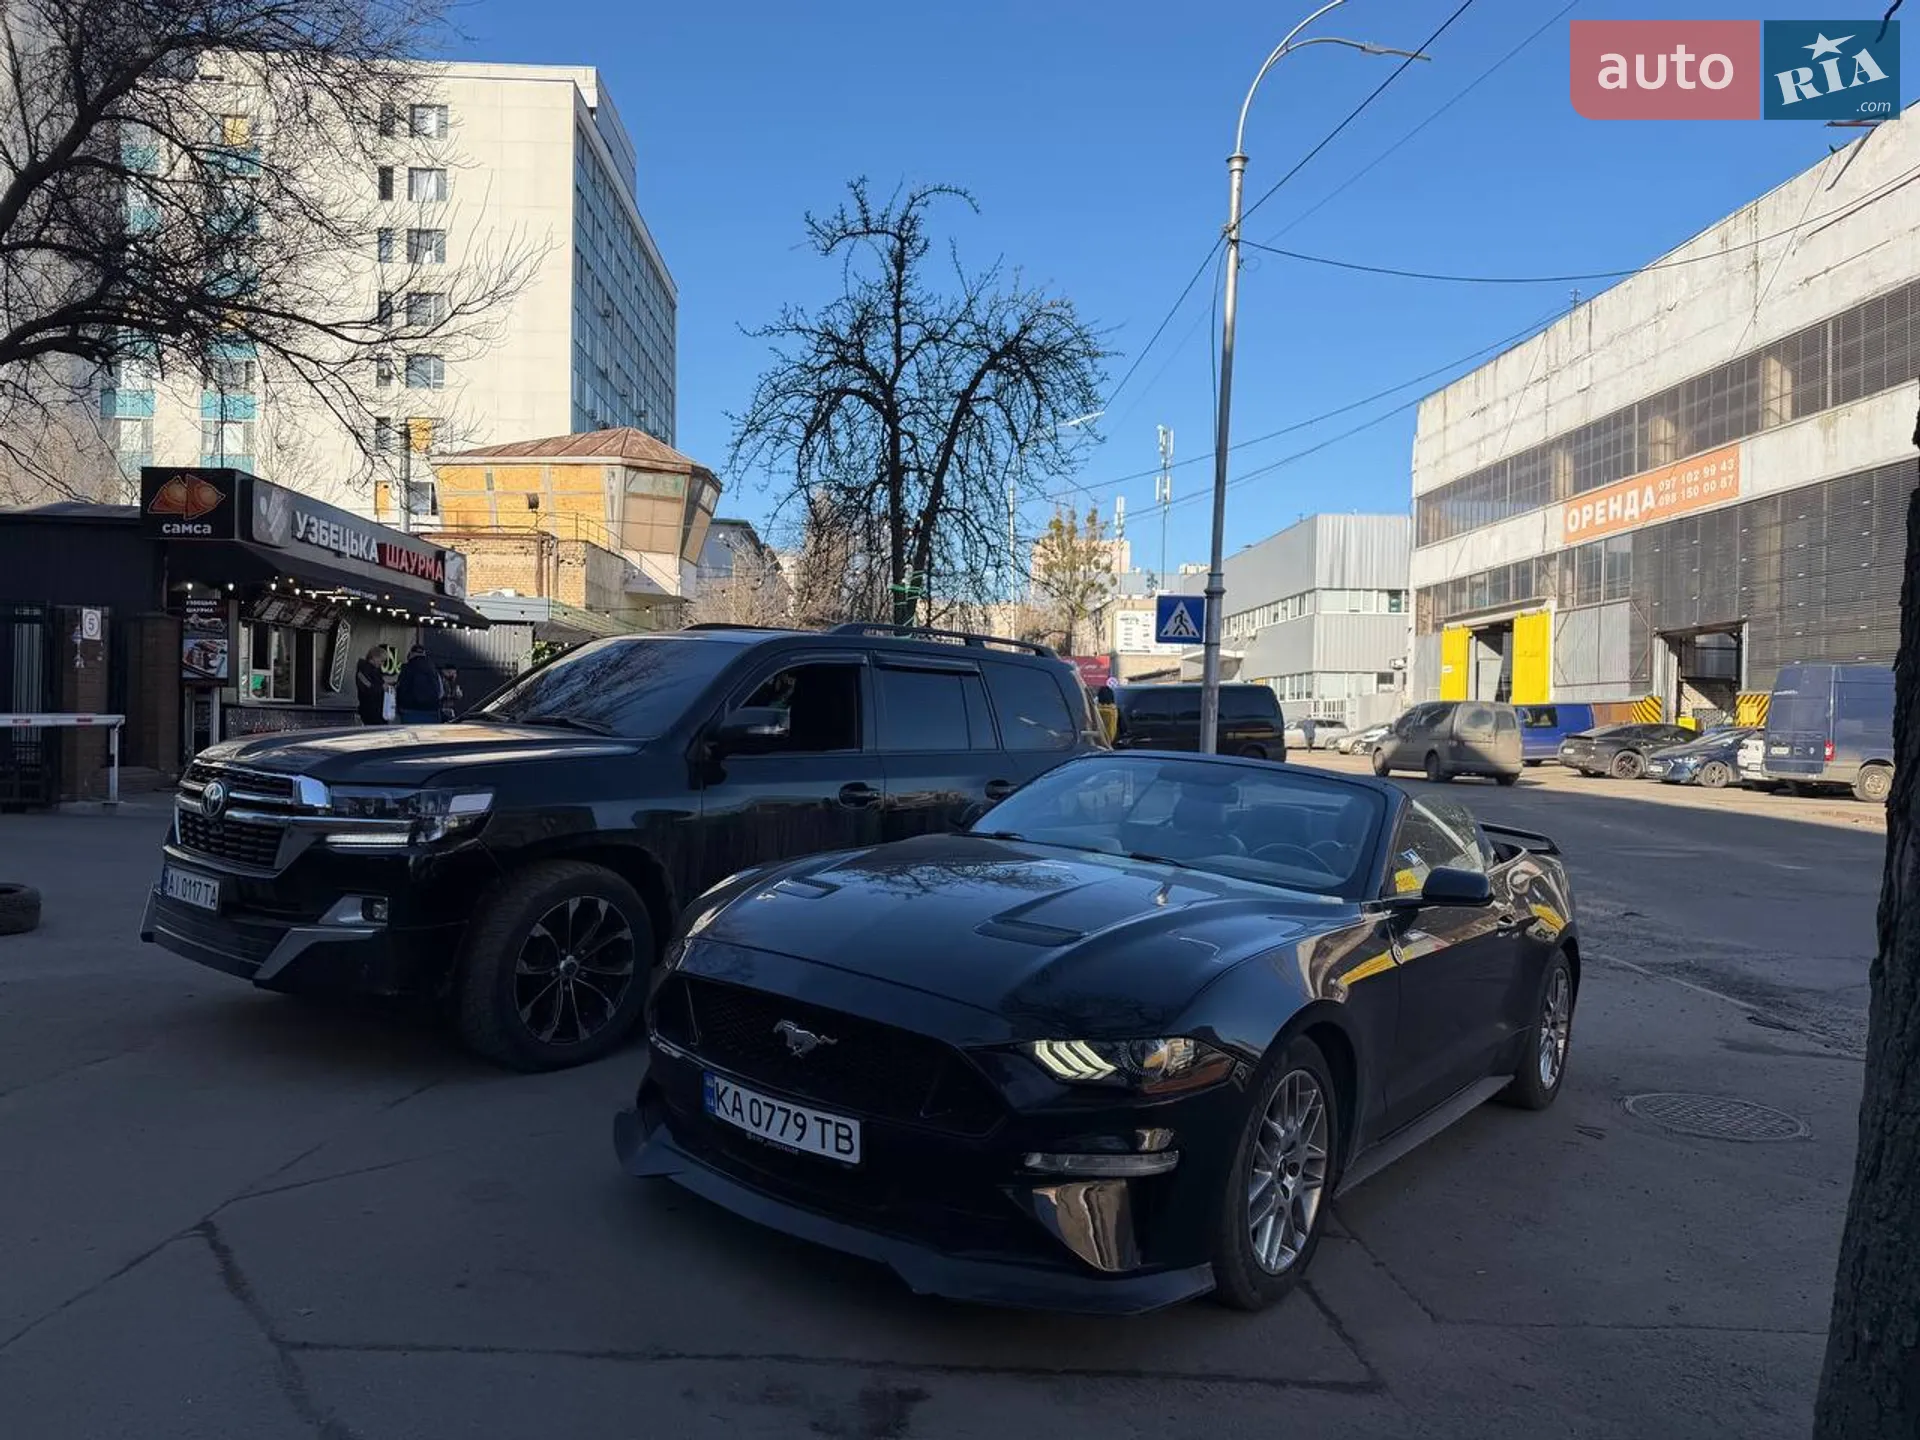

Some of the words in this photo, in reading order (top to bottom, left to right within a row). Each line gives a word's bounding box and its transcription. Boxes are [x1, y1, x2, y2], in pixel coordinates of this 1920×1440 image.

[1720, 457, 1735, 471] 43
[1567, 484, 1656, 533] ОРЕНДА
[162, 523, 212, 534] самса
[296, 511, 380, 564] УЗБЕЦЬКА
[386, 543, 445, 584] ШАУРМА
[88, 618, 95, 632] 5
[204, 883, 216, 907] TA
[715, 1082, 745, 1122] KA
[750, 1098, 807, 1142] 0779
[814, 1116, 855, 1155] TB
